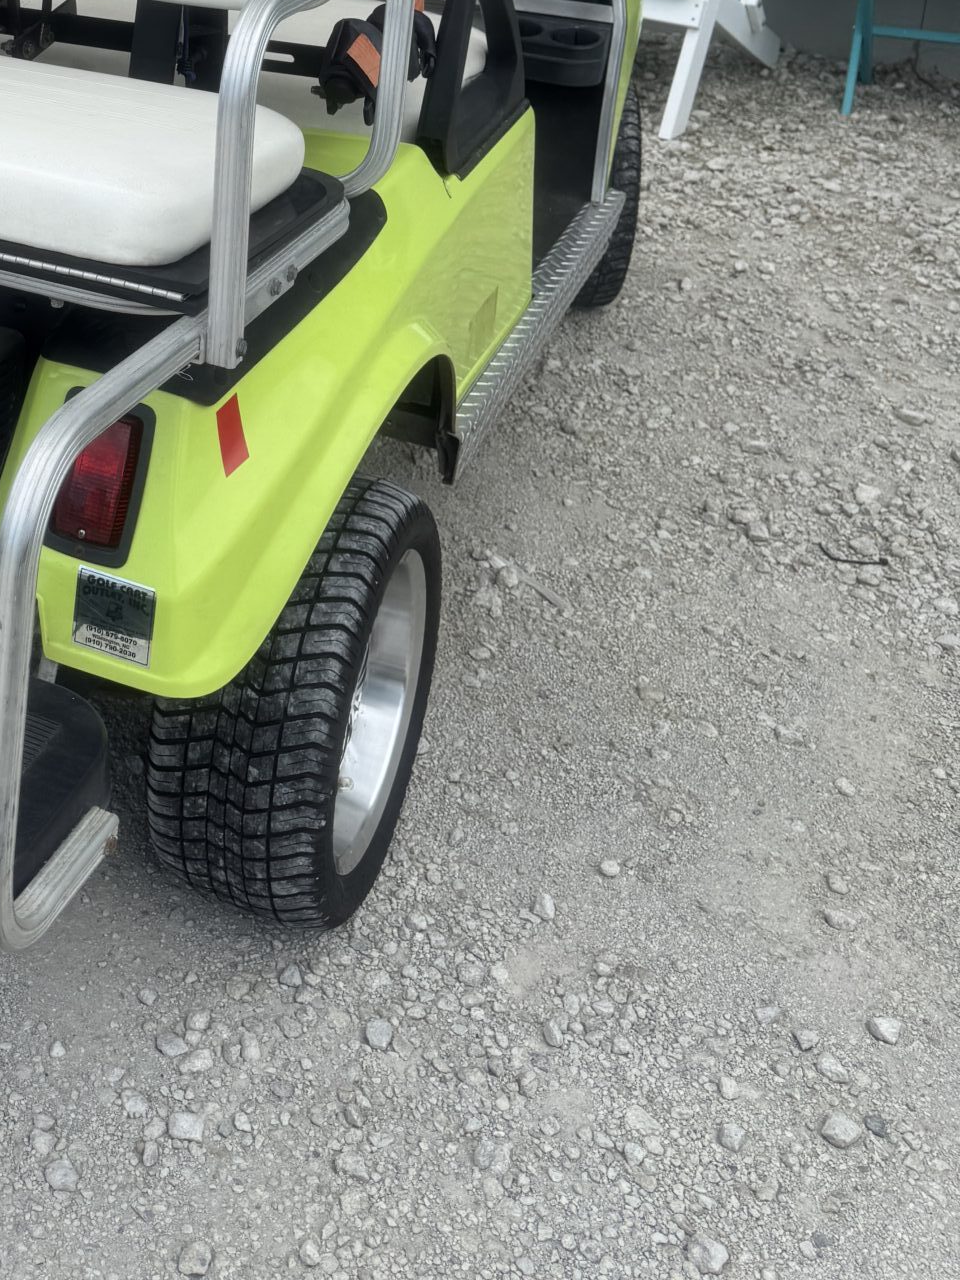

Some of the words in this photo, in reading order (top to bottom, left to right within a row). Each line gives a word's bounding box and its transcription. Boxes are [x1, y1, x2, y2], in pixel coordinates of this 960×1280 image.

[86, 574, 117, 590] GOLF
[120, 585, 148, 601] CART
[85, 636, 103, 649] (910)
